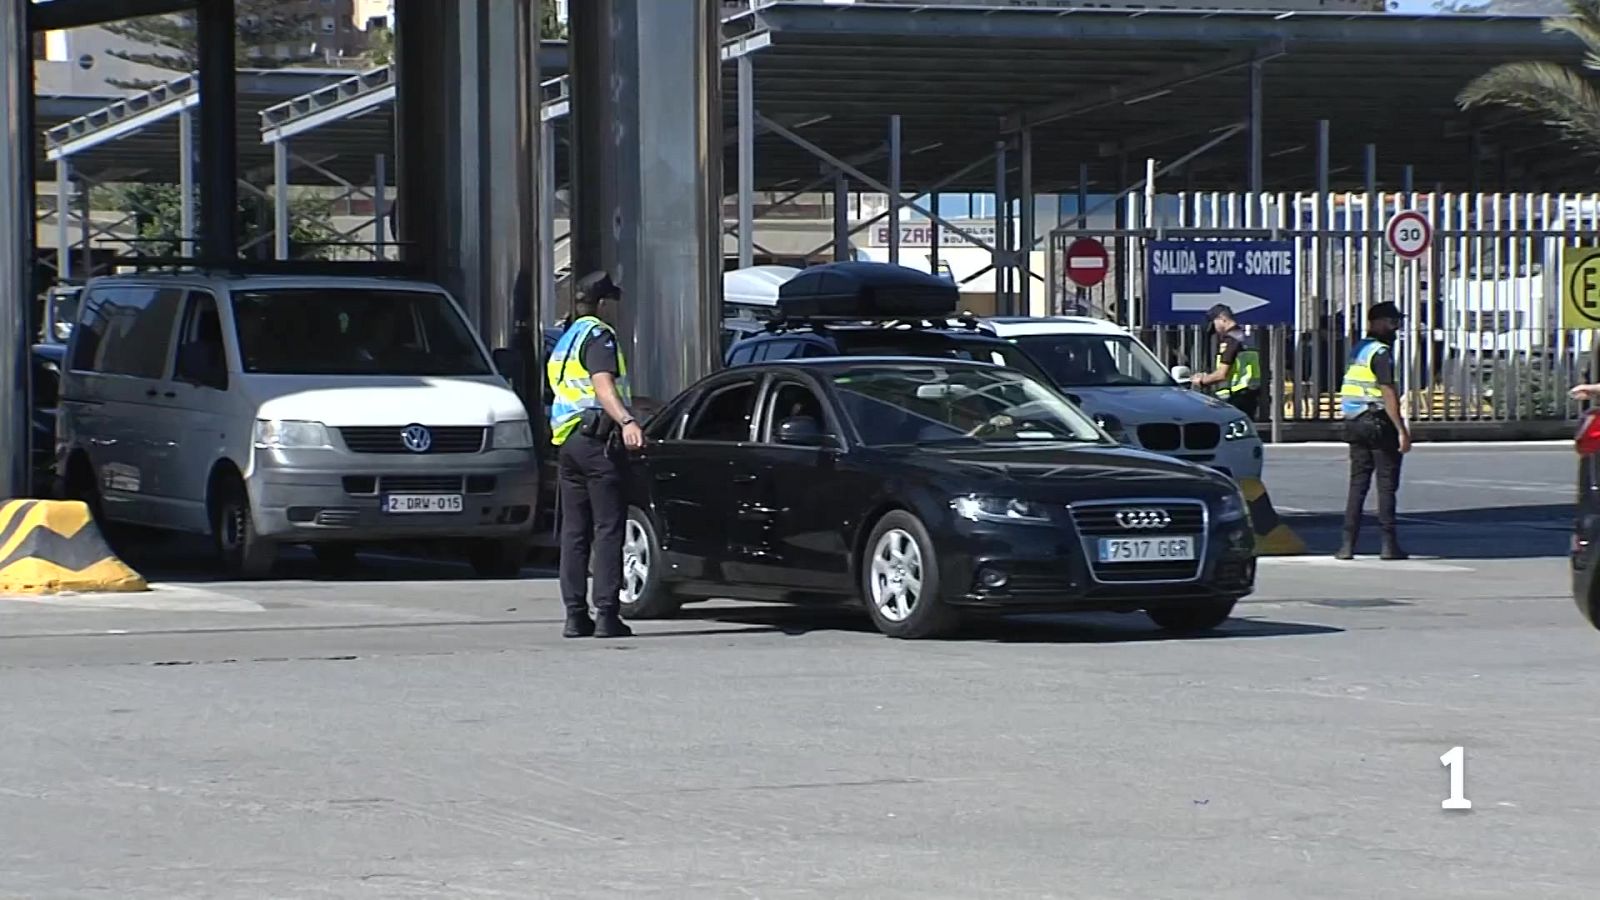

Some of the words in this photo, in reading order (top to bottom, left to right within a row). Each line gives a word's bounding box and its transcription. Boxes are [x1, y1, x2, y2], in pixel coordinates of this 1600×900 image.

[878, 228, 937, 243] BZAR
[1400, 228, 1420, 241] 30
[1153, 250, 1197, 275] SALIDA
[1207, 250, 1236, 275] EXIT
[1245, 250, 1292, 275] SORTIE
[391, 497, 460, 510] 2-DRW-015
[1111, 540, 1150, 558] 7517
[1158, 540, 1189, 557] GGR
